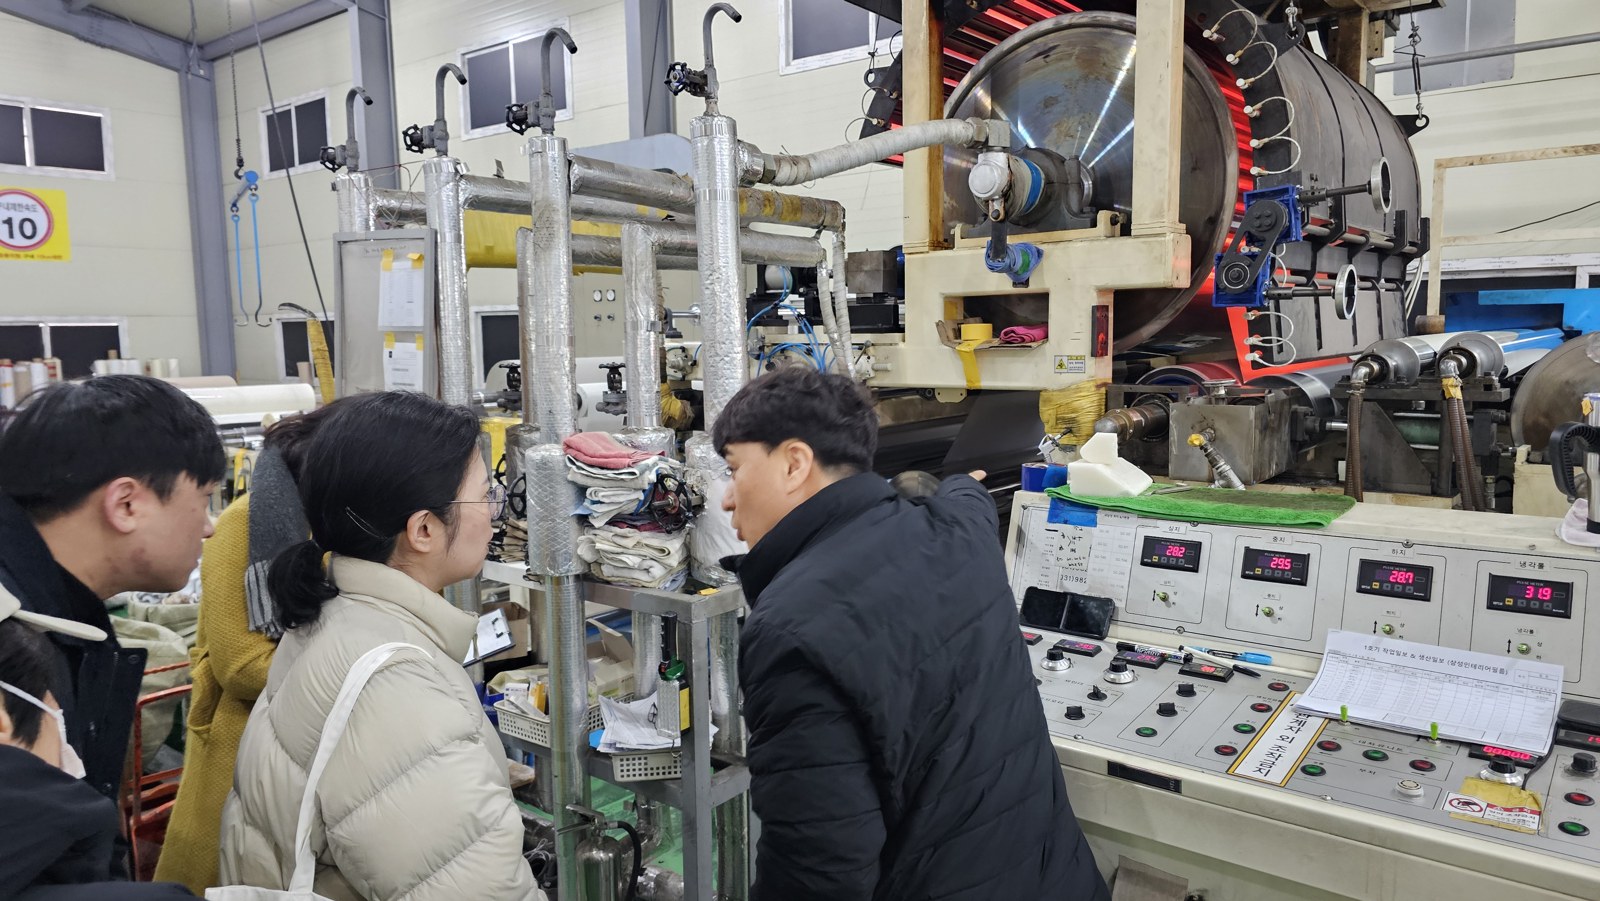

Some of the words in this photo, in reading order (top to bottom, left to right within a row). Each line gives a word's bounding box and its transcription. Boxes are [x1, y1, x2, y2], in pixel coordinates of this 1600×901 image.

[2, 216, 37, 240] 10
[1520, 561, 1544, 569] 냉각롤
[1276, 735, 1295, 744] 외
[1252, 744, 1287, 777] 조작금지
